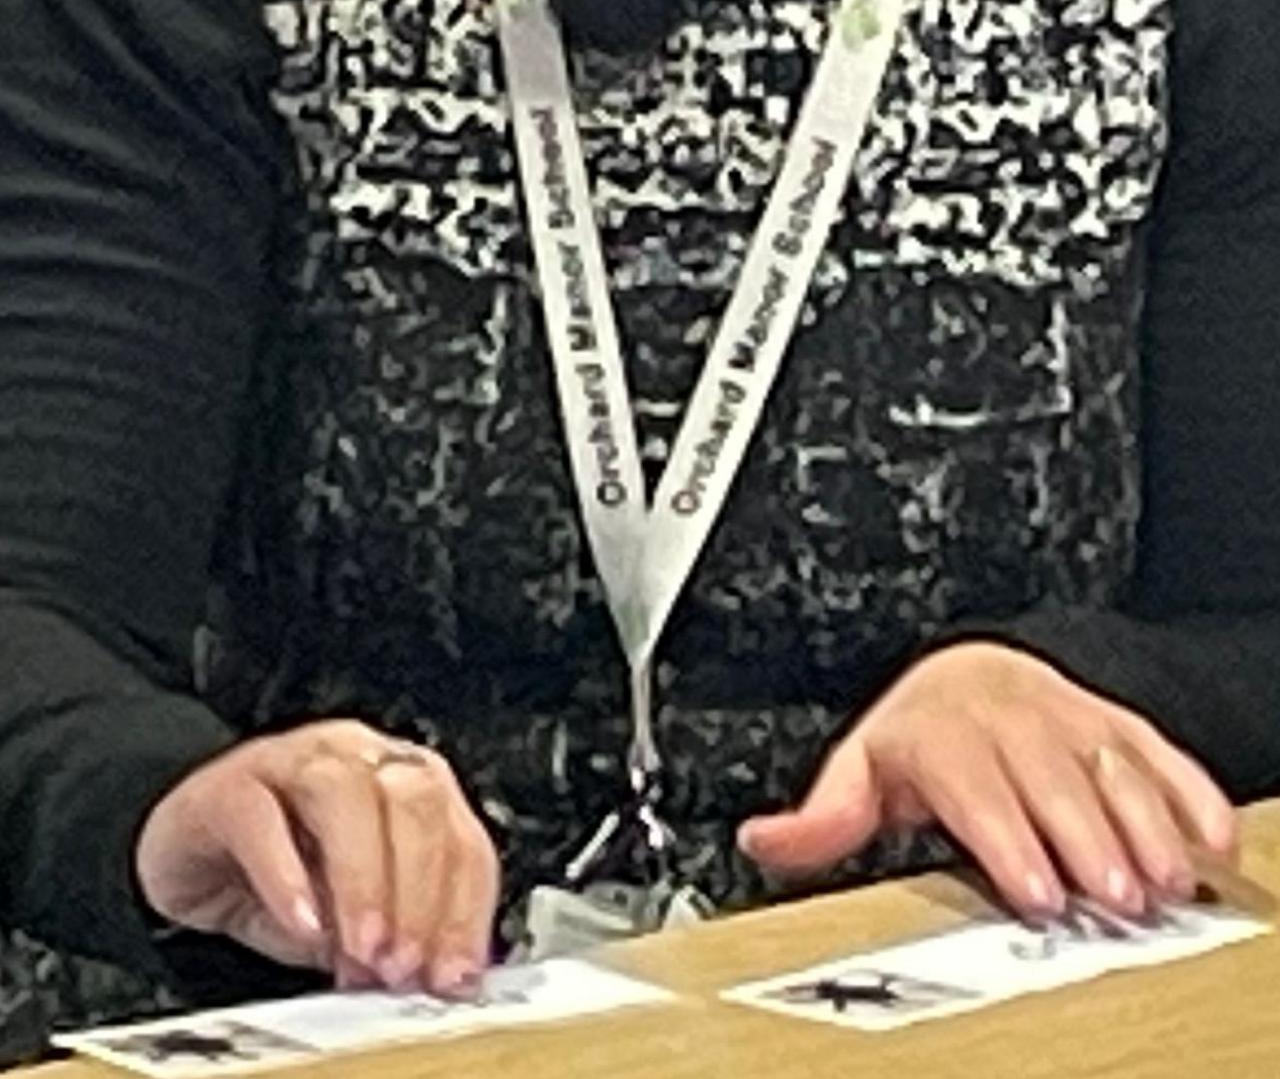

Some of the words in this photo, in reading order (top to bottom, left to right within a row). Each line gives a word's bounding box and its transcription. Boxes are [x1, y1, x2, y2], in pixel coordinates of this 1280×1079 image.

[531, 106, 577, 231] School
[557, 240, 598, 352] Manor
[670, 380, 747, 517] Orchard
[729, 268, 787, 370] Manor
[772, 137, 838, 258] School
[575, 362, 629, 508] Orchard
